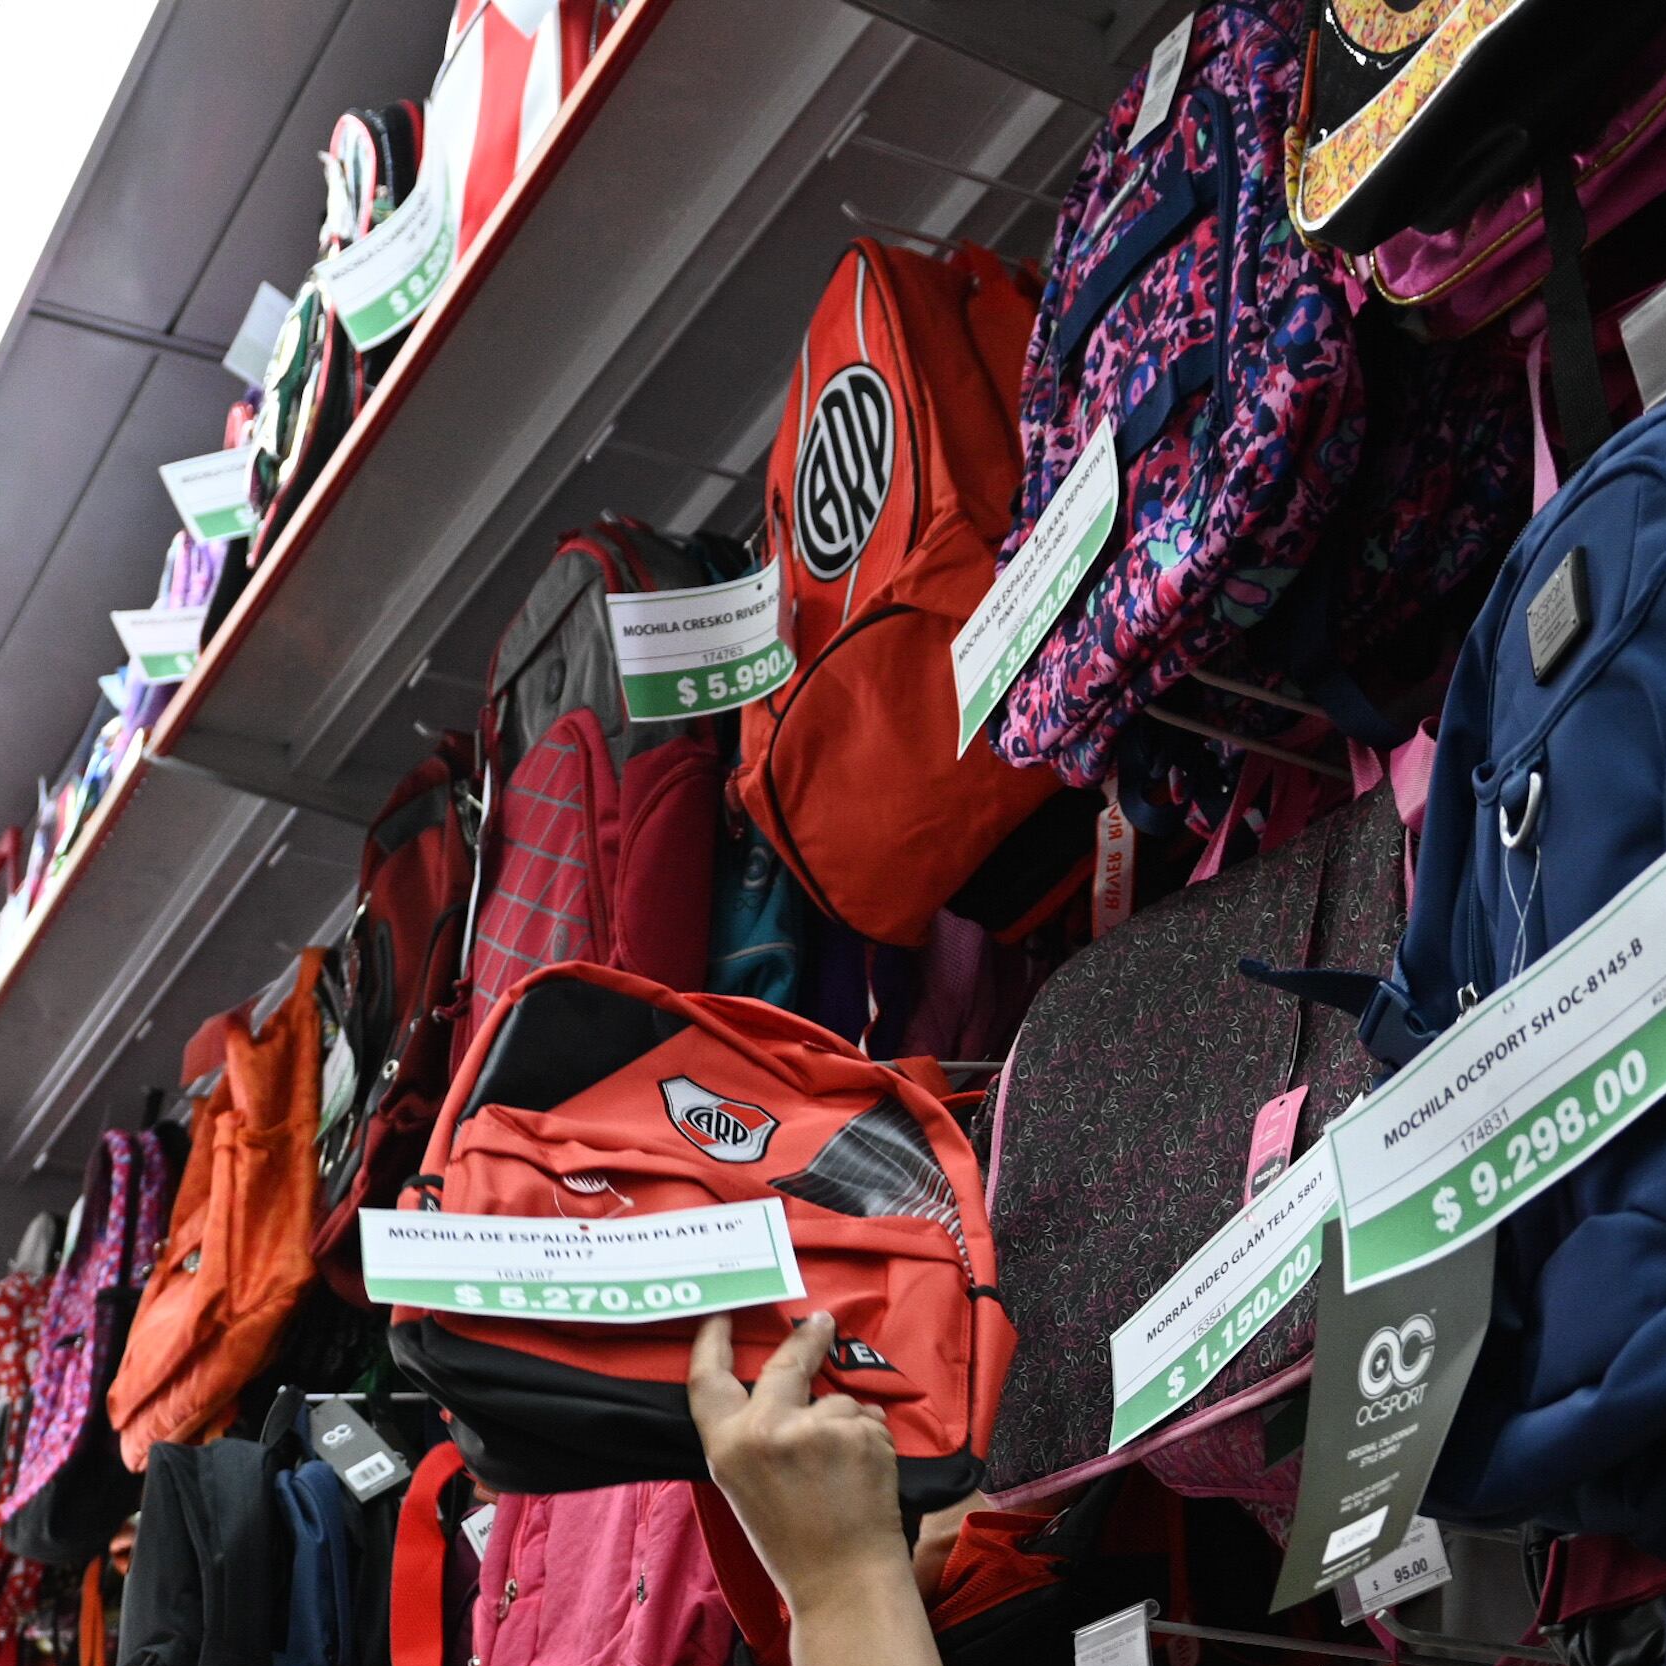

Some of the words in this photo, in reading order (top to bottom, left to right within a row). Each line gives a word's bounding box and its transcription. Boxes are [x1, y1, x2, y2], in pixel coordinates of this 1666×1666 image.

[958, 611, 991, 664] MOCHILA
[991, 596, 1004, 618] DE
[1003, 554, 1036, 602] ESPALDA
[1035, 510, 1068, 558] PELIKAN
[1064, 444, 1107, 516] DEPORTIVA
[623, 619, 680, 637] MOCHILA
[683, 612, 733, 631] CRESKO
[736, 600, 767, 621] RIVER
[997, 597, 1020, 631] PINKY
[1003, 554, 1081, 676] 3.990.00
[677, 677, 698, 707] $
[1383, 1083, 1456, 1151] MOCHILA
[1456, 1026, 1527, 1093] OCSPORT
[1533, 1006, 1555, 1035] SH
[1558, 937, 1645, 1015] OC-8145-B
[1433, 1186, 1463, 1234] $
[1469, 1049, 1647, 1207] 9.298.00
[1460, 1107, 1511, 1154] 174831
[388, 1227, 475, 1242] MOCHILA
[479, 1230, 505, 1244] DE
[509, 1229, 591, 1245] ESPALDA
[597, 1227, 649, 1244] RIVER
[654, 1223, 711, 1240] PLATE
[1146, 1295, 1193, 1345] MORRAL
[1195, 1261, 1229, 1299] RIDEO
[1231, 1227, 1266, 1265] GLAM
[1267, 1202, 1296, 1233] TELA
[1297, 1171, 1324, 1205] 5801
[454, 1284, 484, 1308] $
[499, 1280, 702, 1312] 5.270.00
[1167, 1366, 1186, 1399] $
[1195, 1244, 1312, 1373] 1.150.00
[1355, 1382, 1429, 1427] OCSPORT
[1394, 1557, 1428, 1583] 95.00
